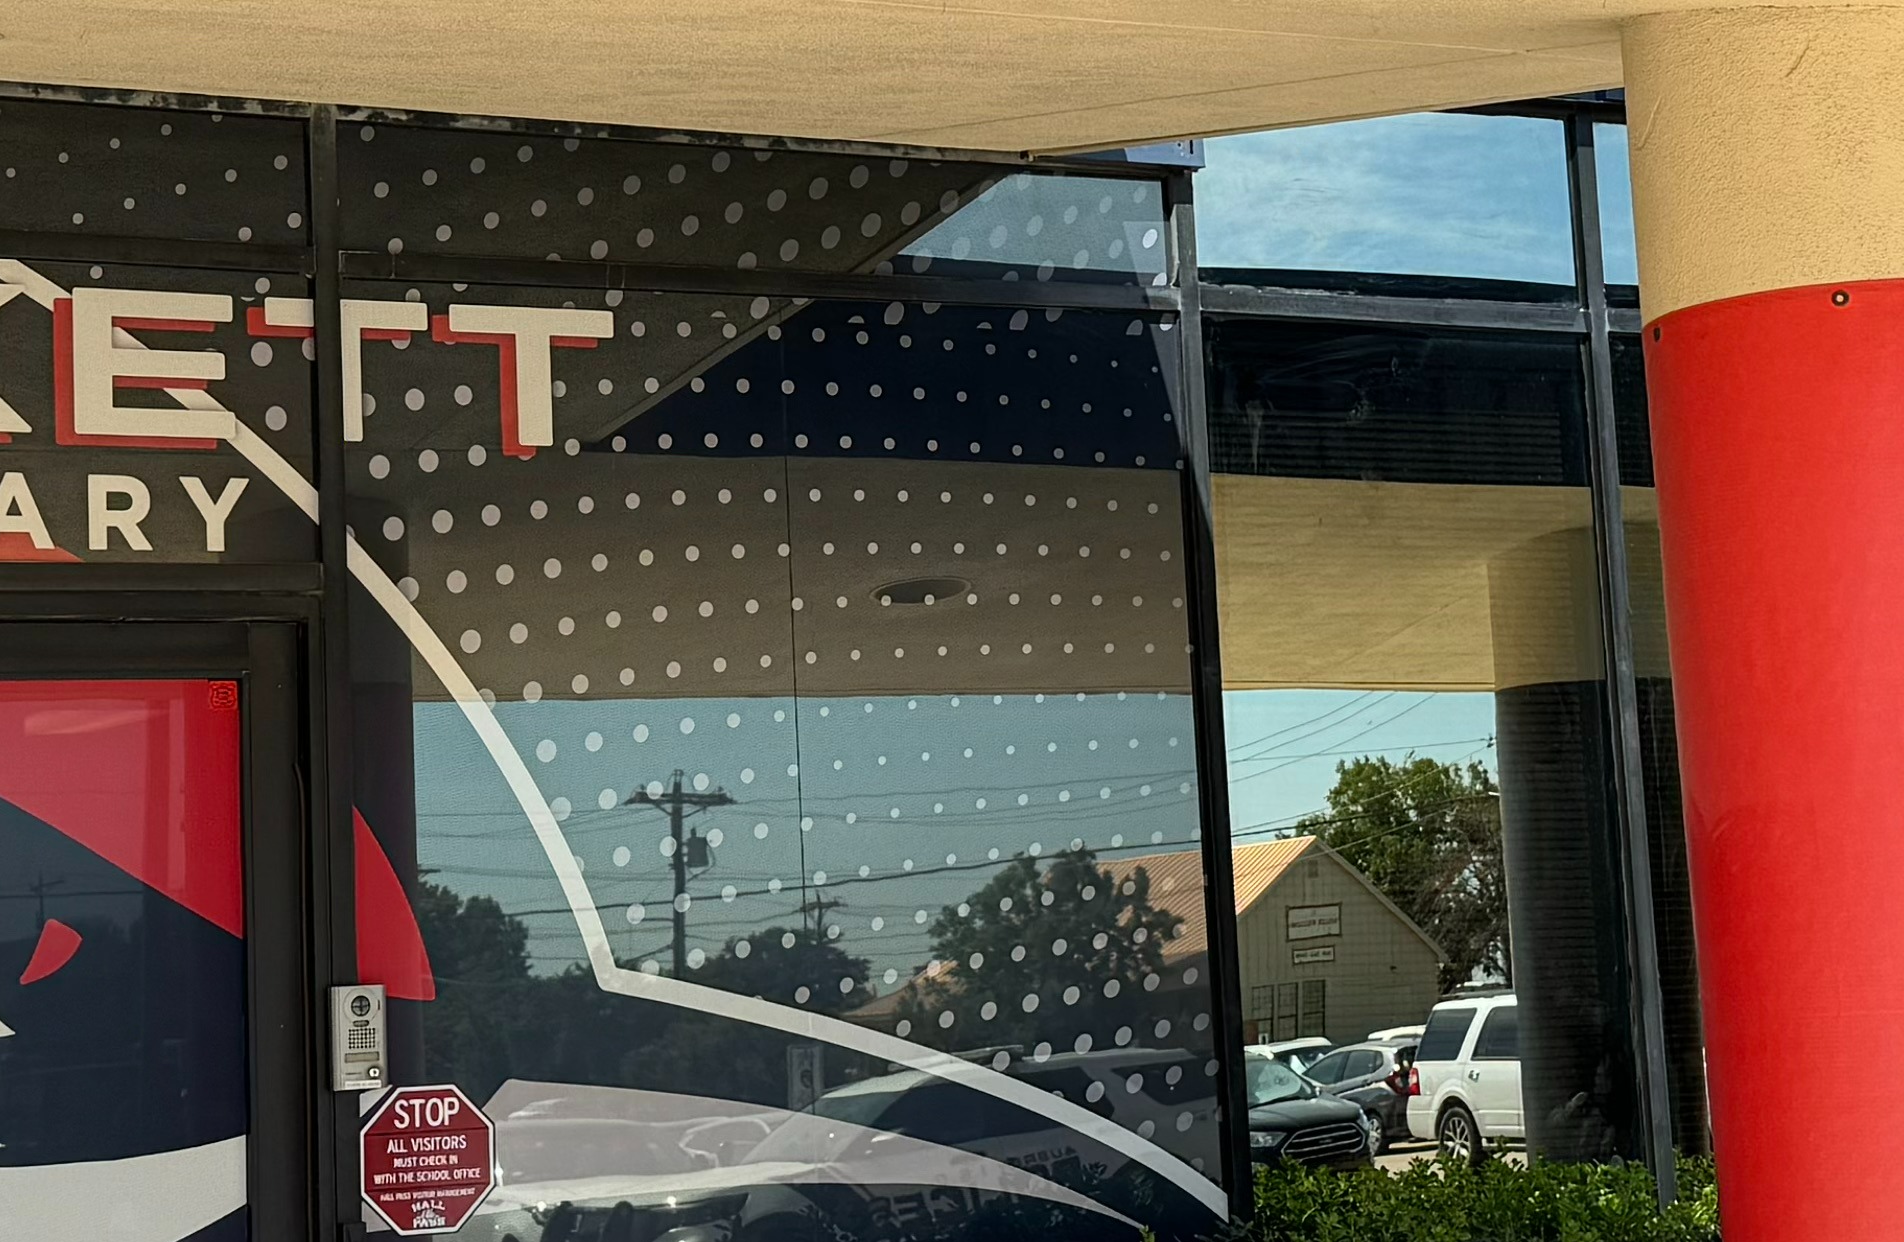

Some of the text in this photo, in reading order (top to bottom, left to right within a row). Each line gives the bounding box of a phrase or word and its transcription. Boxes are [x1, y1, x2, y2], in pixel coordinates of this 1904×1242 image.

[393, 1096, 460, 1129] STOP
[387, 1135, 467, 1154] ALL VISITORS
[393, 1154, 459, 1168] MUST CHECK IN
[373, 1167, 482, 1185] WITH THE SCHOOL OFFICE
